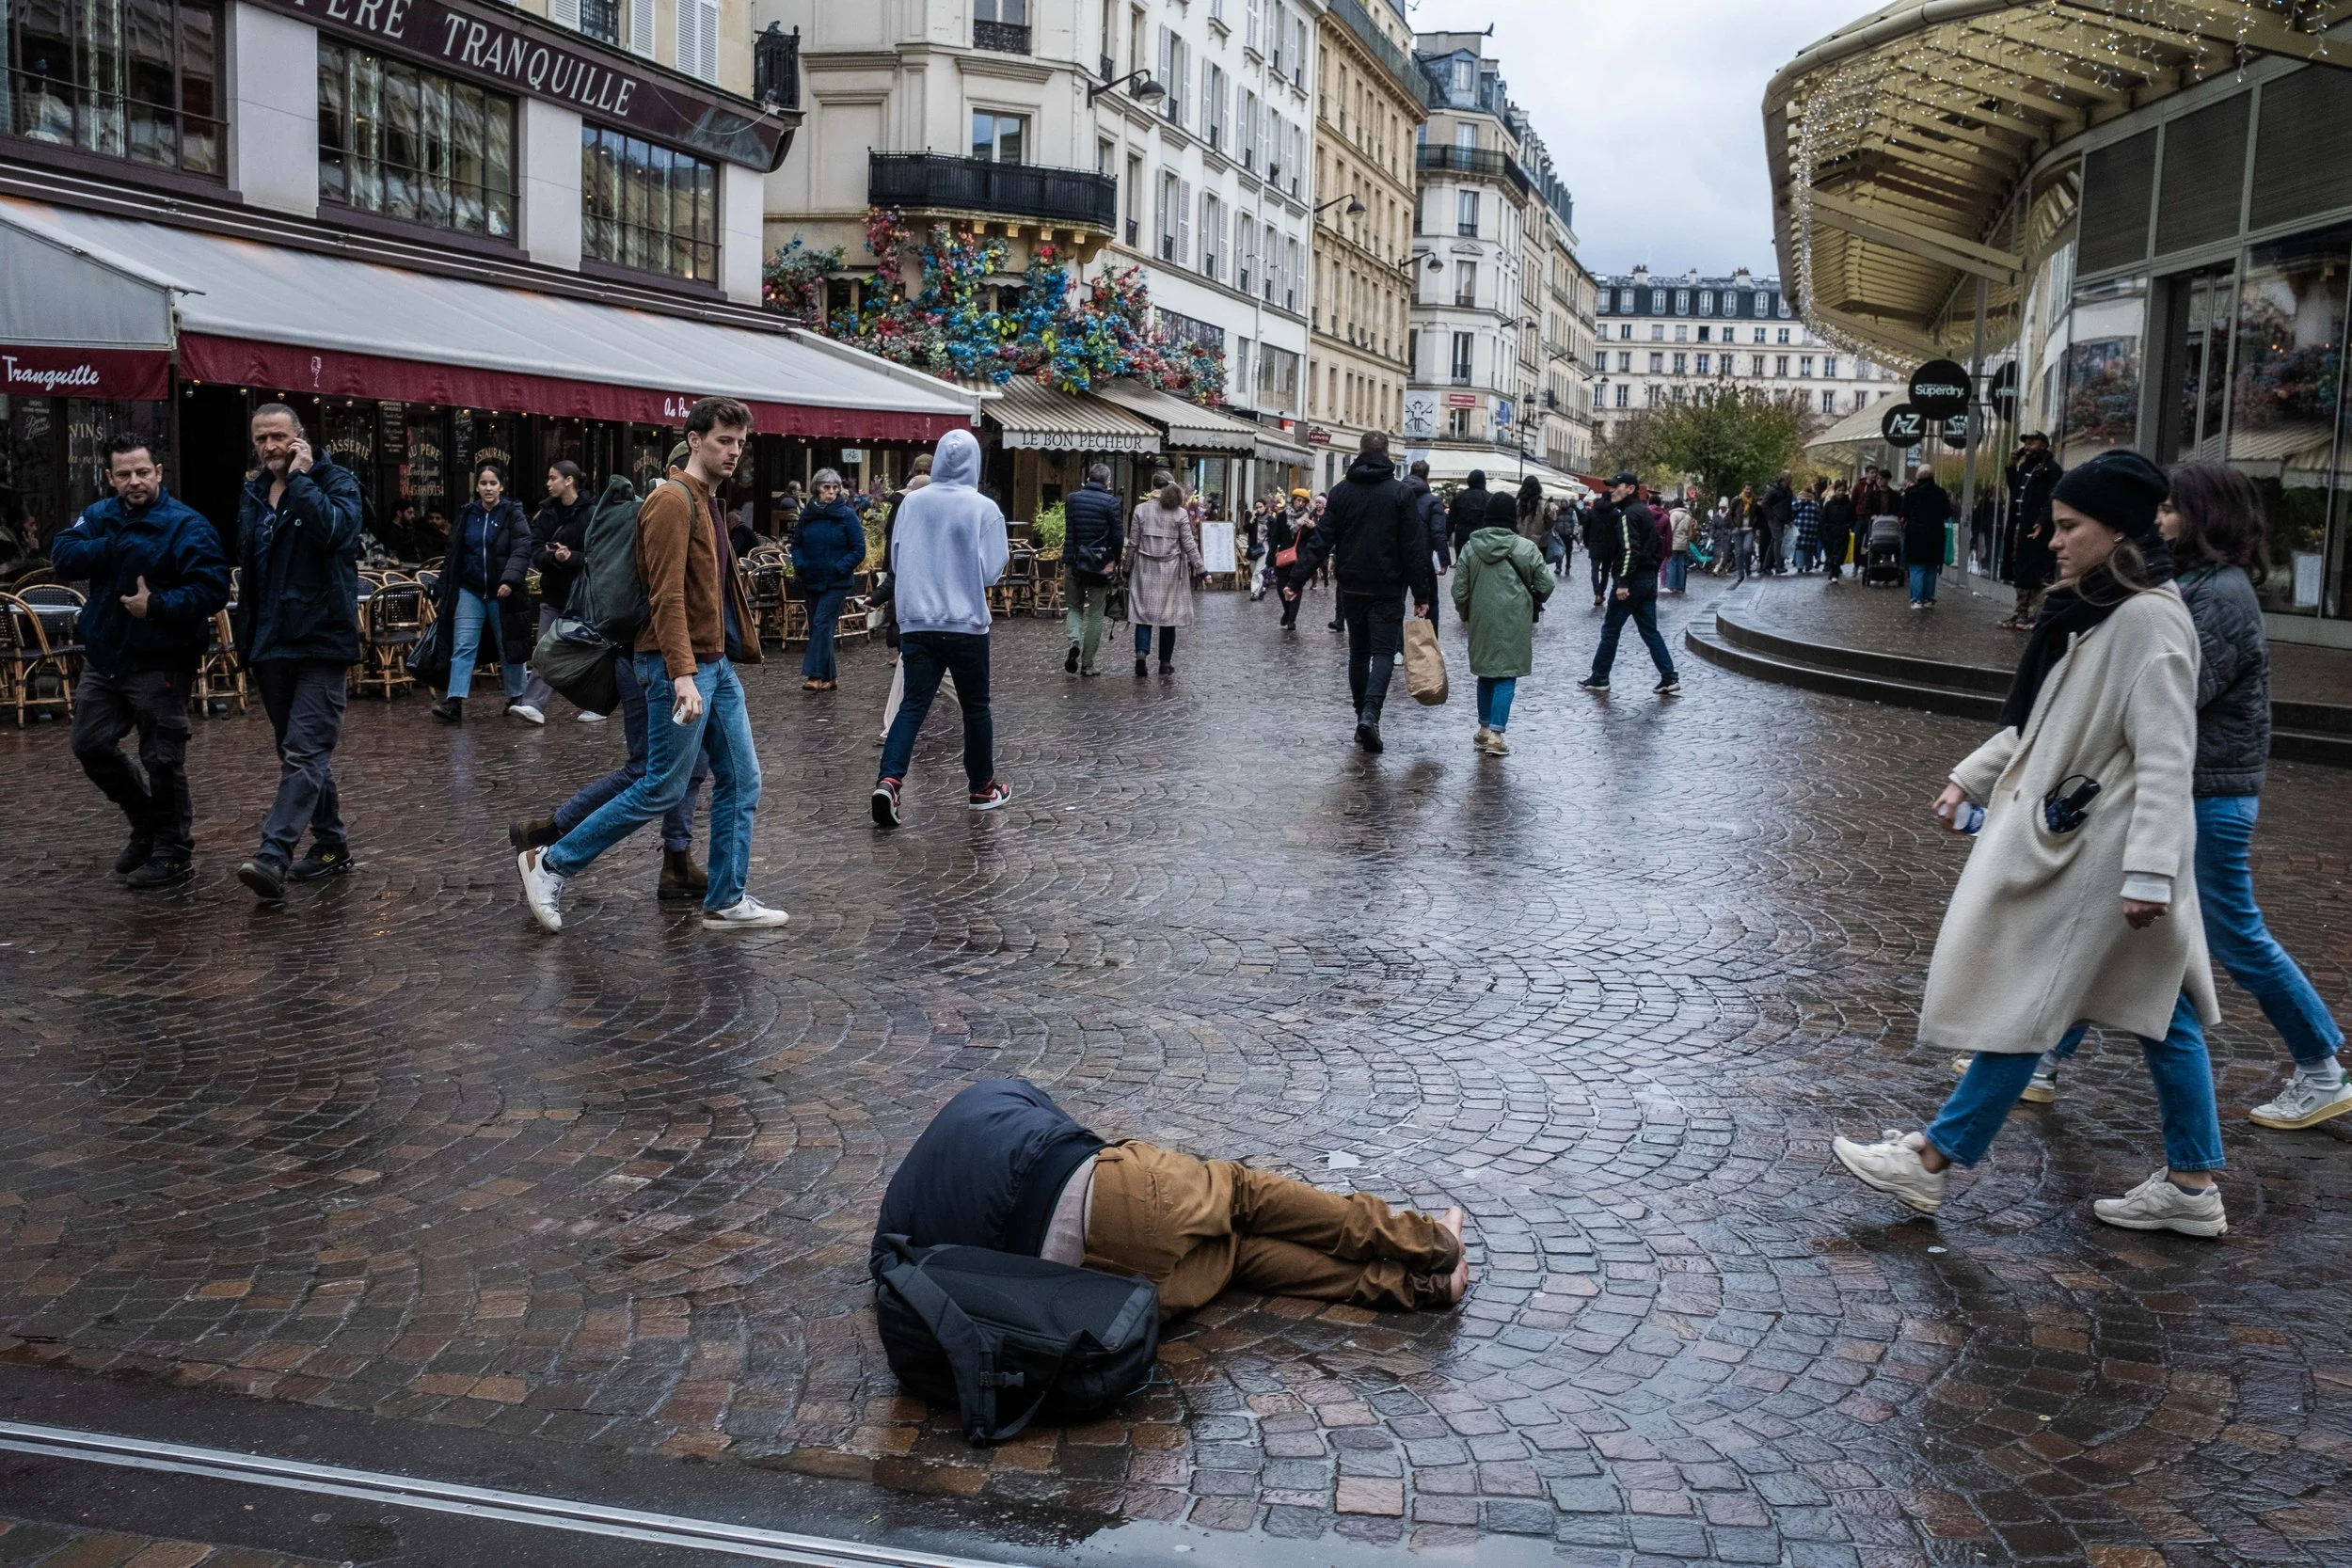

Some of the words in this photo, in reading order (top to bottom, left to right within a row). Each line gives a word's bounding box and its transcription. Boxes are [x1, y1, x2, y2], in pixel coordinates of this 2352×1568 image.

[443, 13, 636, 117] TRANQUILLE
[2, 355, 100, 391] Tranquille
[68, 423, 104, 441] VINS
[1022, 433, 1039, 446] LE
[1043, 434, 1073, 448] BON
[1079, 435, 1142, 450] PECHEUR
